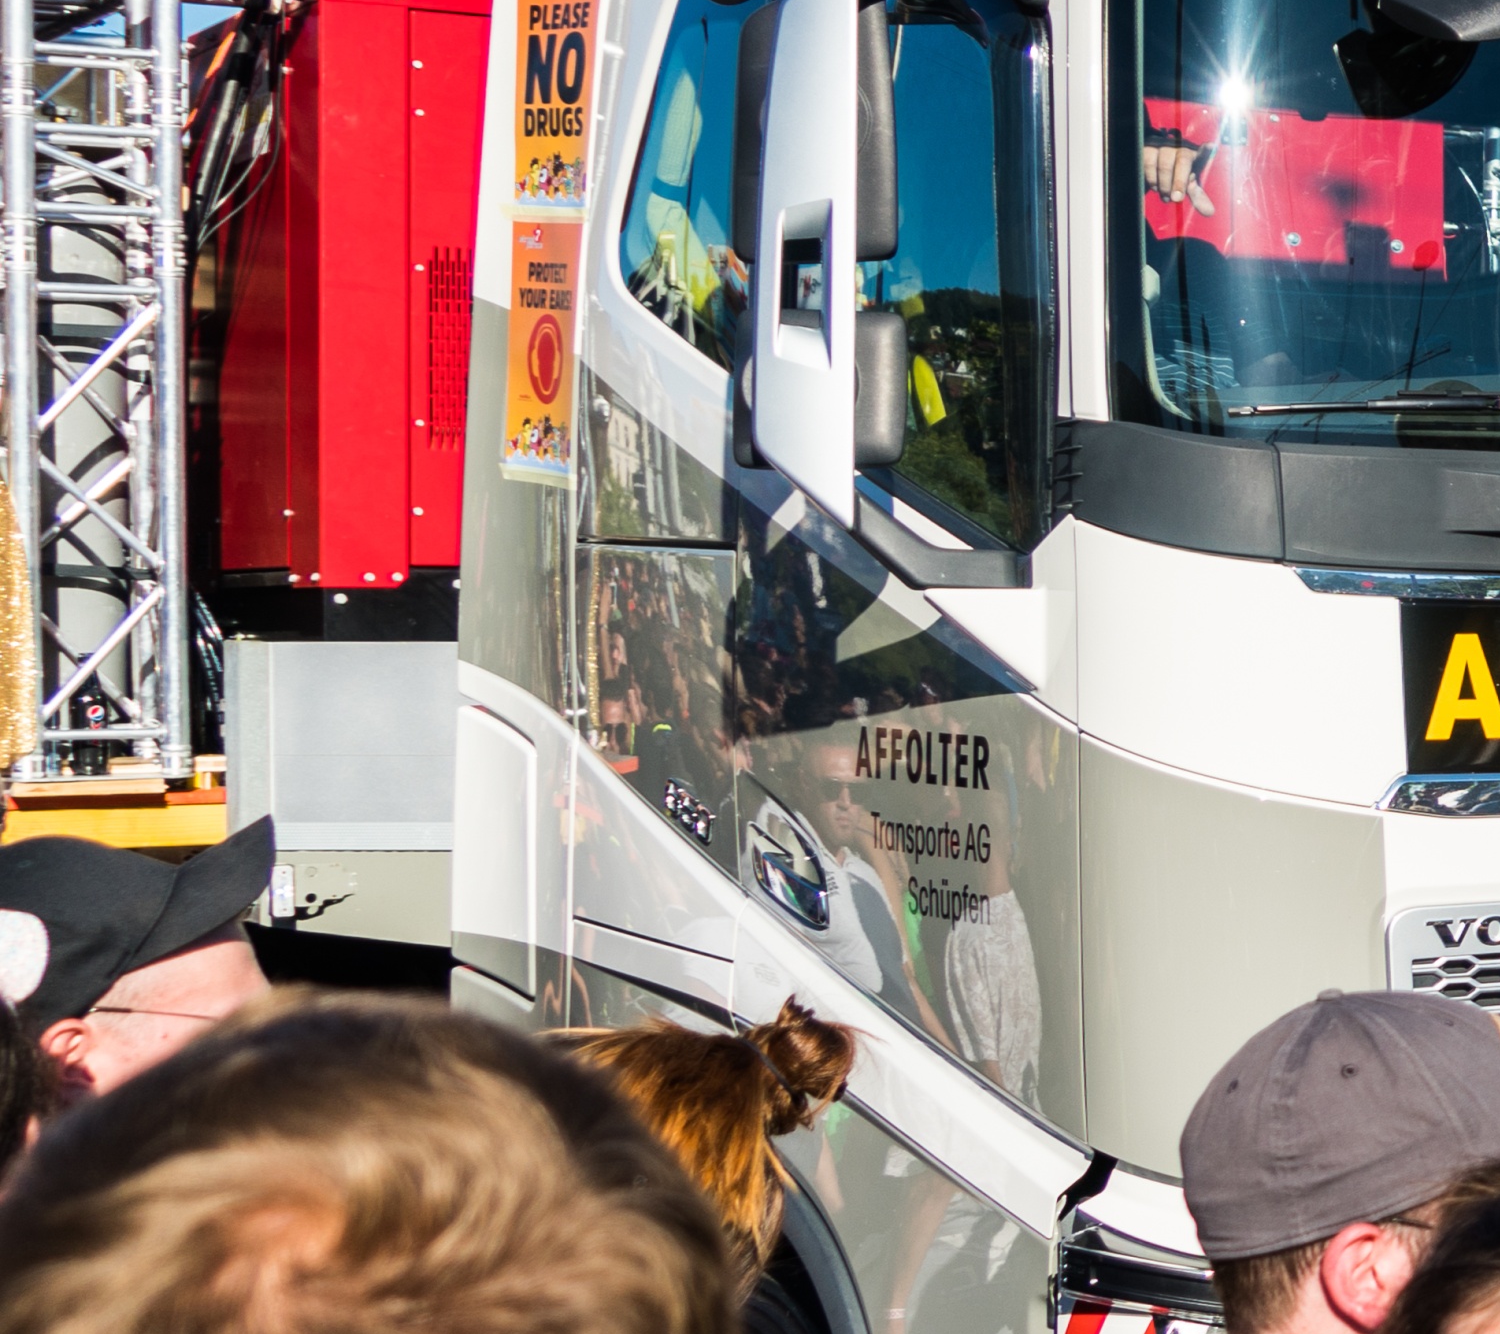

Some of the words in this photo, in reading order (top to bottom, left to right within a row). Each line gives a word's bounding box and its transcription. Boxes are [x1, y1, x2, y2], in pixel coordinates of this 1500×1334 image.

[529, 1, 590, 35] PLEASE
[526, 29, 586, 107] NO
[523, 105, 584, 139] DRUGS
[528, 261, 568, 284] PROTECT
[519, 287, 547, 309] YOUR
[855, 726, 990, 790] AFFOLTER
[871, 811, 960, 864] Transporte
[964, 822, 991, 864] AG
[908, 875, 990, 930] Schüpfen
